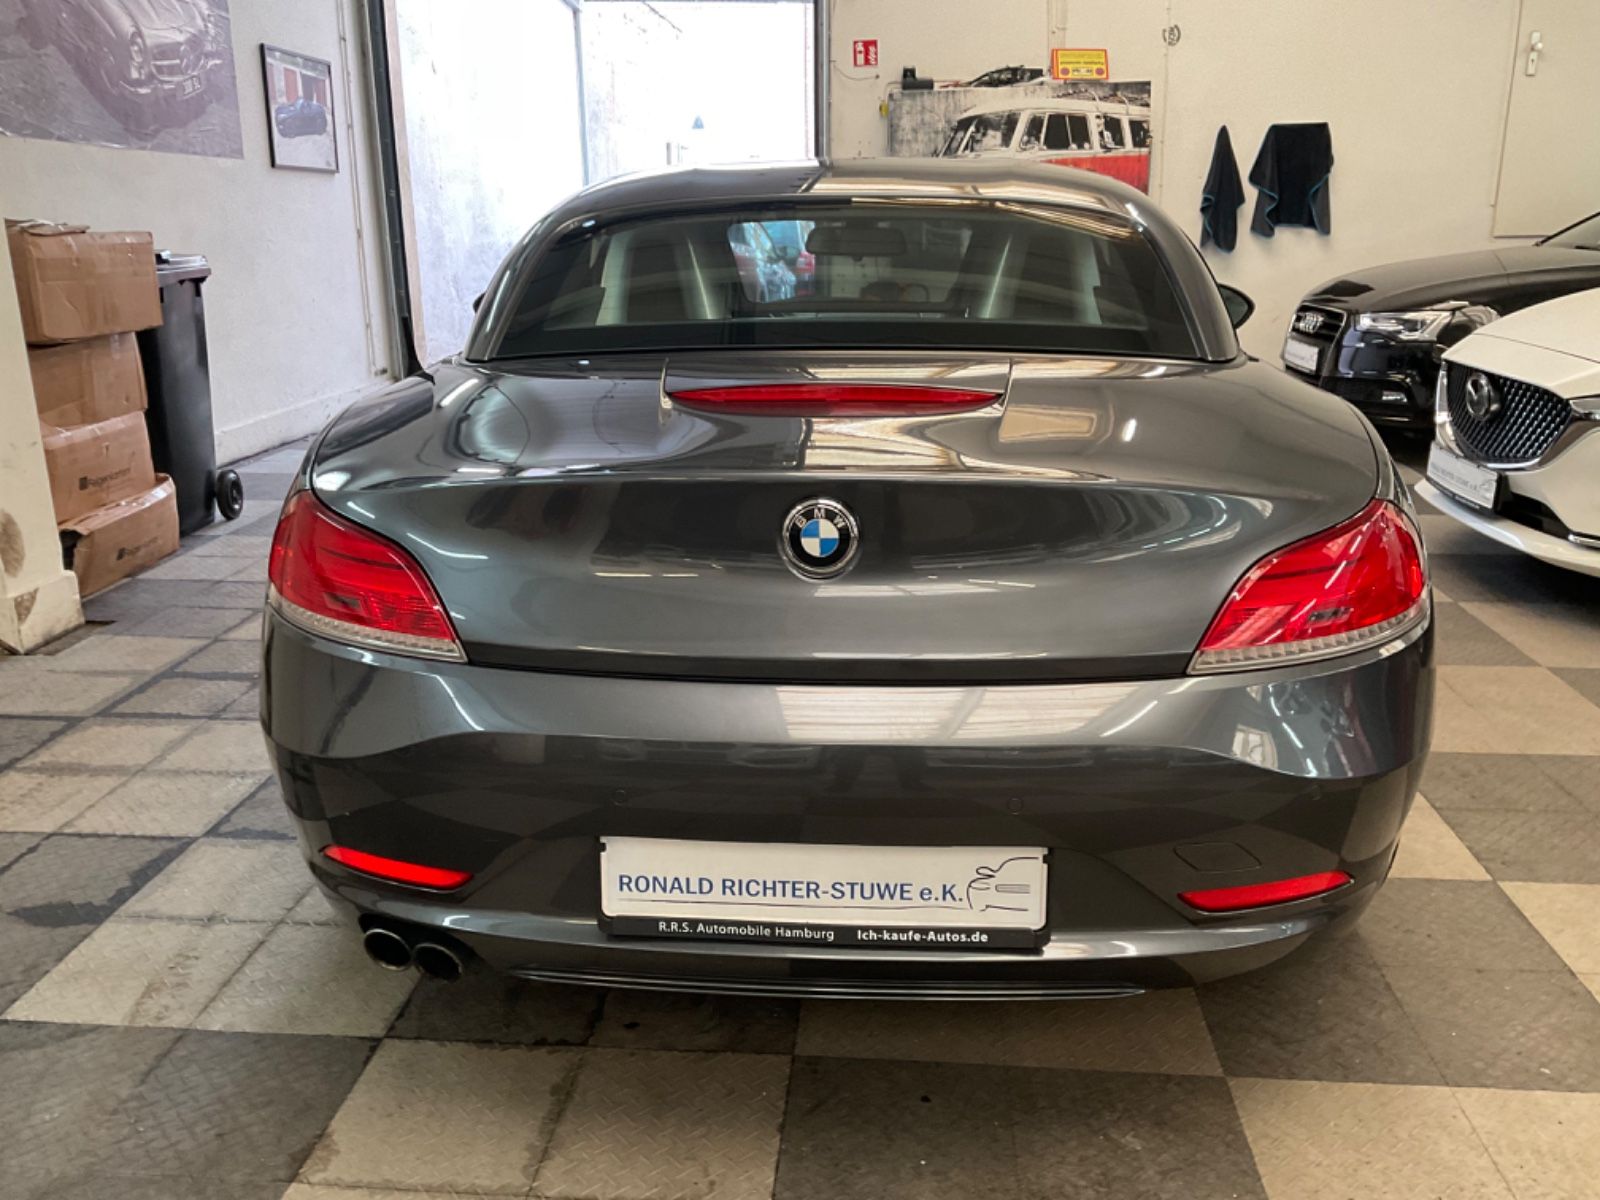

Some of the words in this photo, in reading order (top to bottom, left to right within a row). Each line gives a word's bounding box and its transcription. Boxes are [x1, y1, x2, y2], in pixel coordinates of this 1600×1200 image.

[795, 506, 846, 528] BMW
[618, 874, 714, 895] RONALD
[721, 877, 913, 901] RICHTER-STUWE
[919, 883, 964, 903] e.K.
[658, 920, 694, 934] R.R.S.
[696, 922, 771, 937] Automobile
[775, 926, 834, 942] Hamburg
[857, 929, 989, 942] Ich-kaufe-Autos.de
